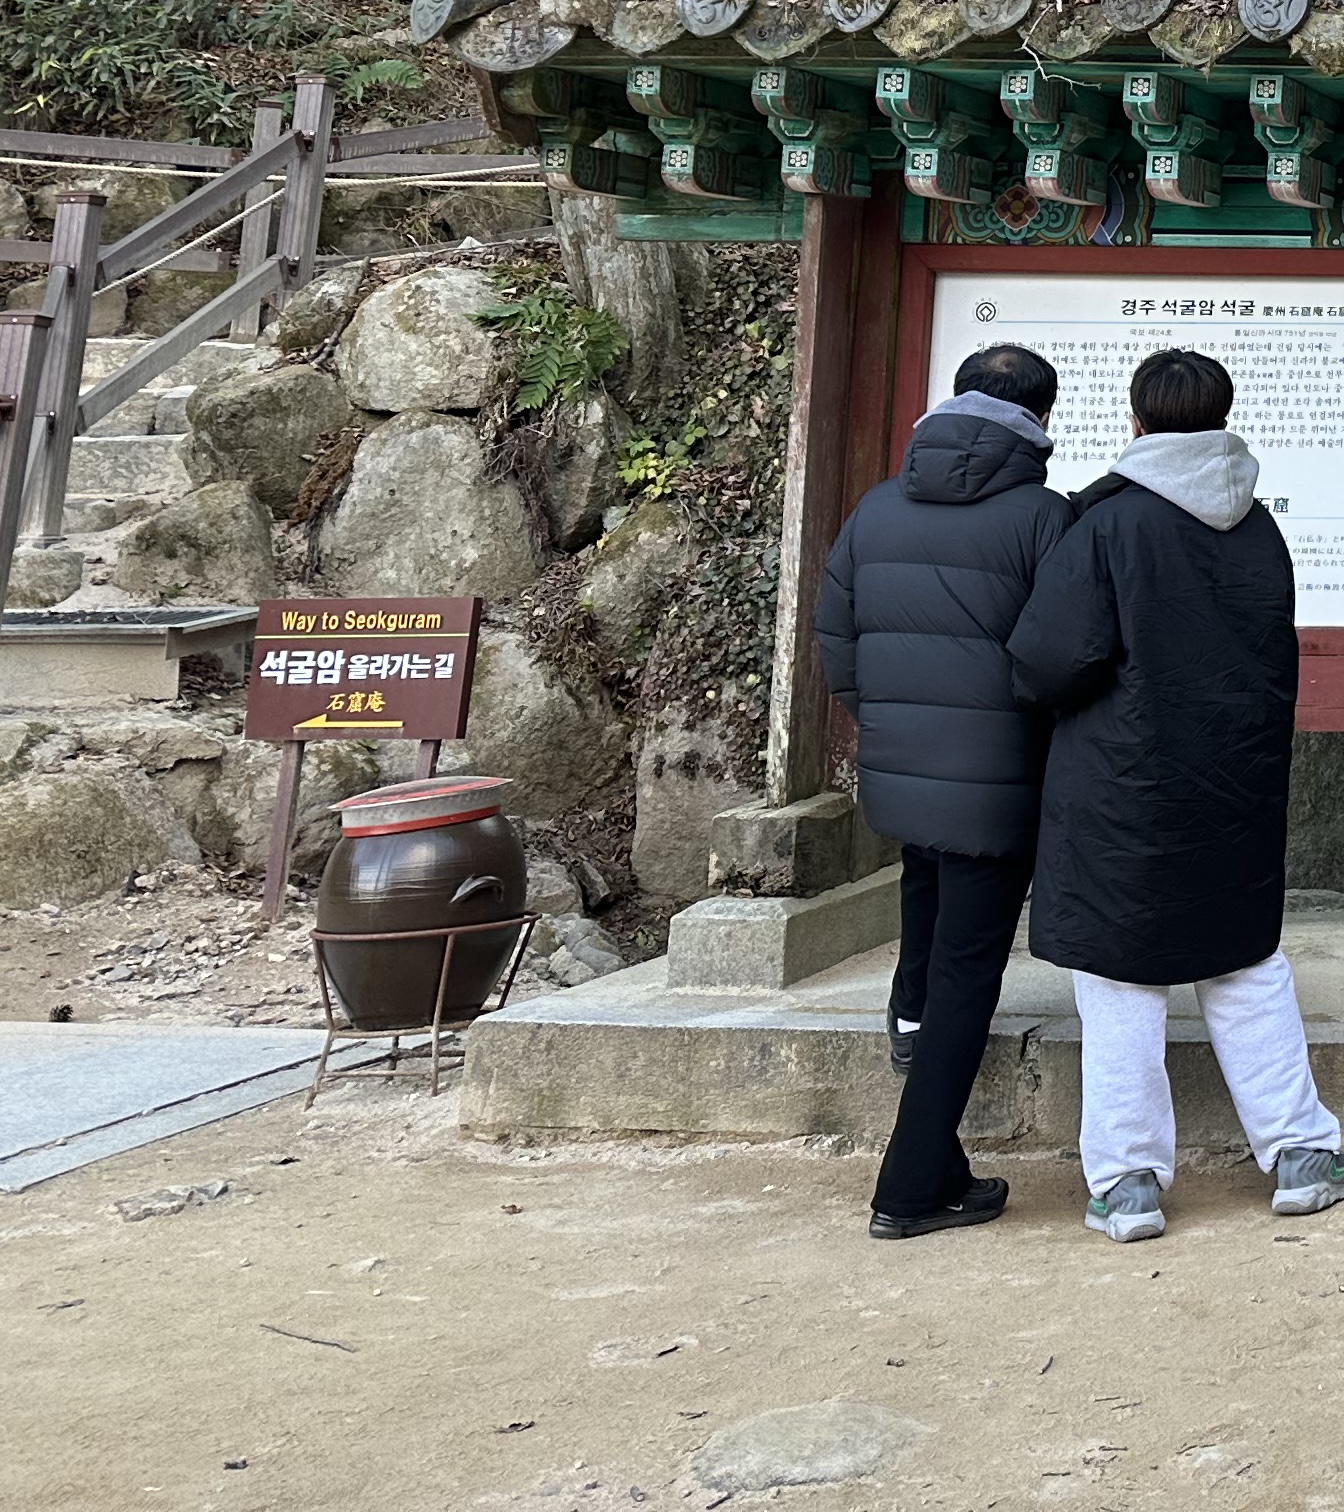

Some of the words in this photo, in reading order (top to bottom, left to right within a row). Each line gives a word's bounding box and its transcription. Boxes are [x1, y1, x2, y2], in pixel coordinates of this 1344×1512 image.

[1120, 299, 1156, 316] 경주
[1161, 299, 1215, 316] 석굴암
[1220, 299, 1255, 316] 석굴
[282, 612, 317, 633] Way
[322, 612, 340, 630] to
[344, 610, 442, 632] Seokguram
[259, 649, 346, 685] 석굴암
[326, 690, 386, 713] 石窟庵
